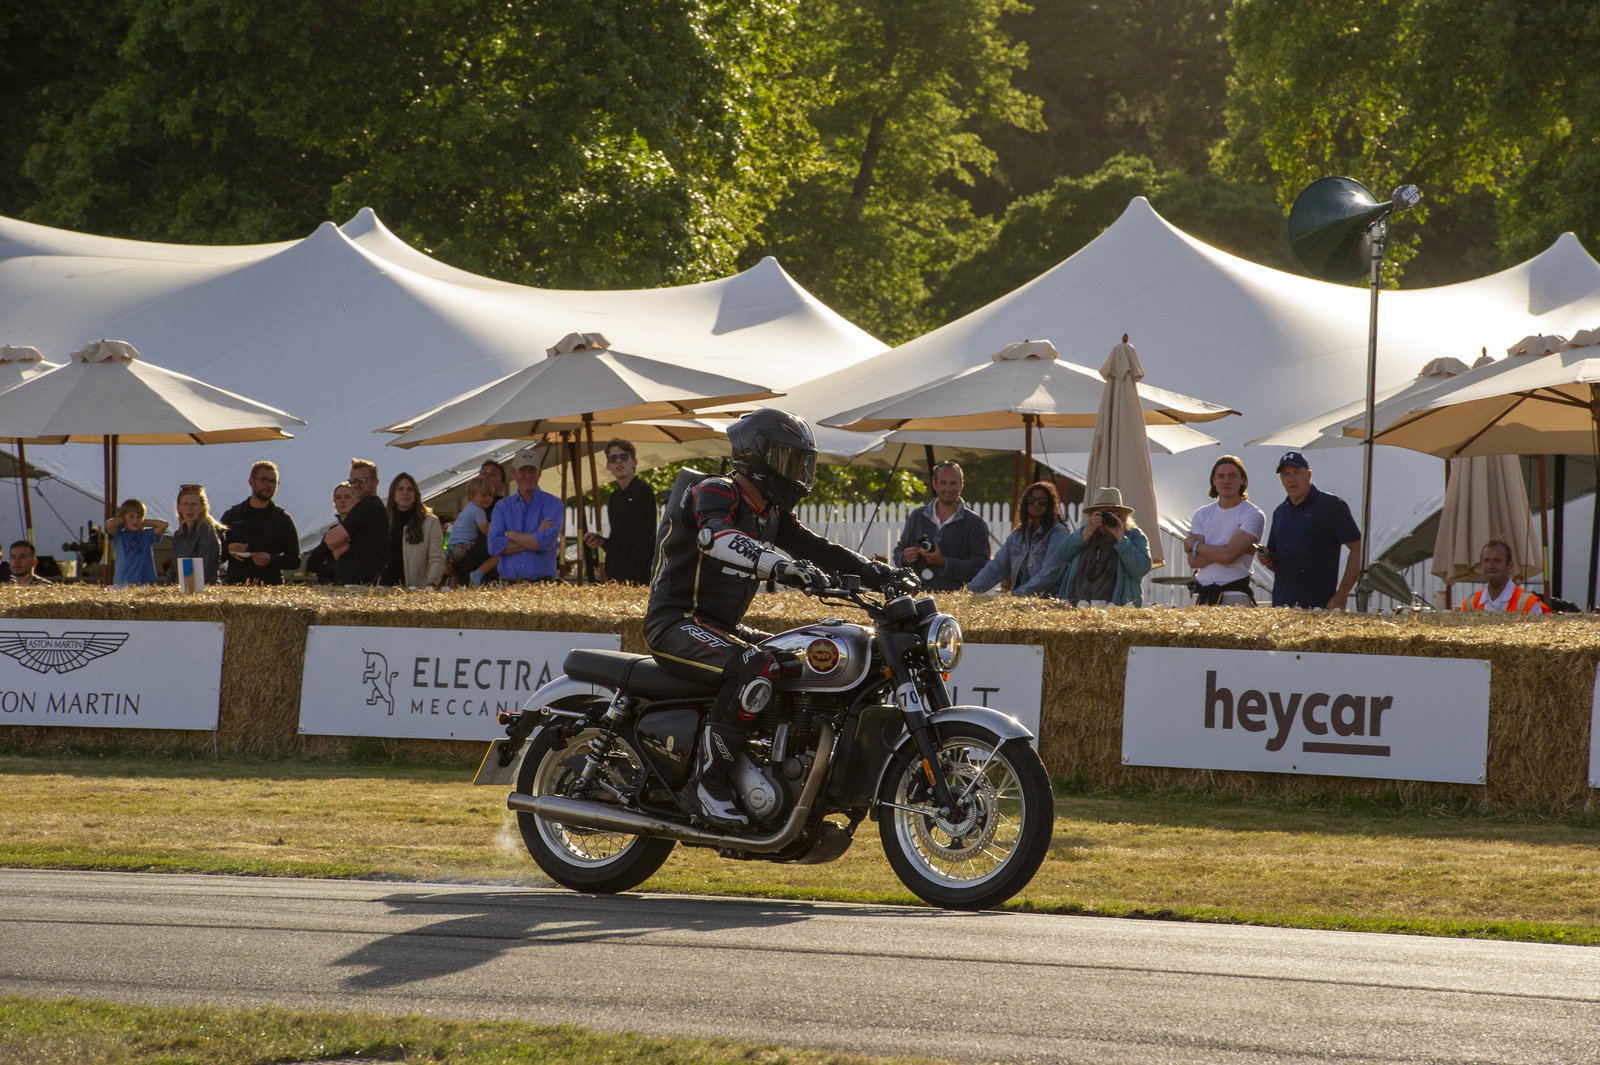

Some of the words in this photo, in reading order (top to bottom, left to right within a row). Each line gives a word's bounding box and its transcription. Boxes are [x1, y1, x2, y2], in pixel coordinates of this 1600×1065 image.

[28, 640, 53, 648] ASTON
[54, 641, 83, 649] MARTIN
[680, 624, 732, 648] RST
[412, 656, 552, 691] ELECTRA
[0, 691, 36, 713] ON
[46, 692, 140, 715] MARTIN
[410, 698, 520, 717] MECCANI
[899, 690, 919, 707] 70
[1203, 670, 1394, 752] heycar
